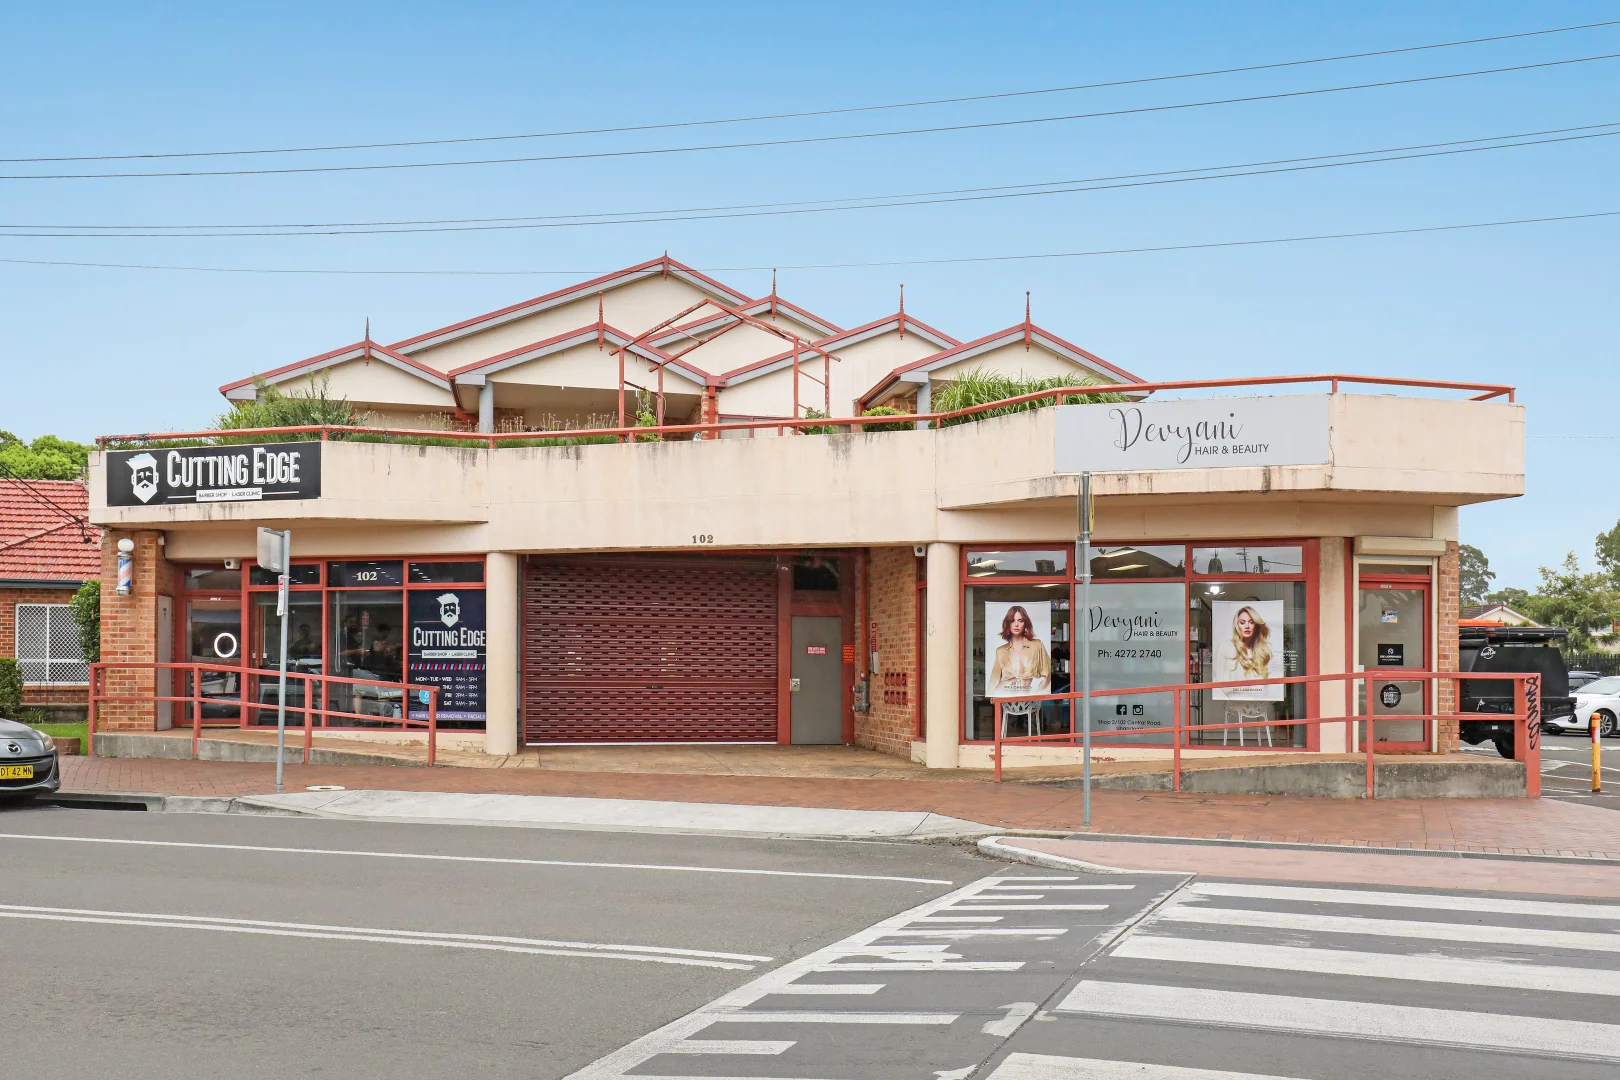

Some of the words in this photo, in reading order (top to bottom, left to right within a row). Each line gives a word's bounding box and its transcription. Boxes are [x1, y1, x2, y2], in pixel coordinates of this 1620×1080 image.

[1109, 408, 1244, 464] Devyani
[1194, 445, 1218, 455] HAIR
[1221, 445, 1229, 454] &
[1232, 444, 1269, 454] BEAUTY
[167, 450, 249, 488] CUTTING
[252, 447, 301, 484] EDGE
[691, 534, 714, 544] 102
[355, 571, 378, 581] 102
[1088, 606, 1164, 641] Devyani
[413, 626, 458, 647] CUTTING
[460, 626, 486, 647] EDGE
[1097, 649, 1112, 658] Ph:
[1114, 649, 1137, 658] 4272
[1139, 649, 1162, 658] 2740
